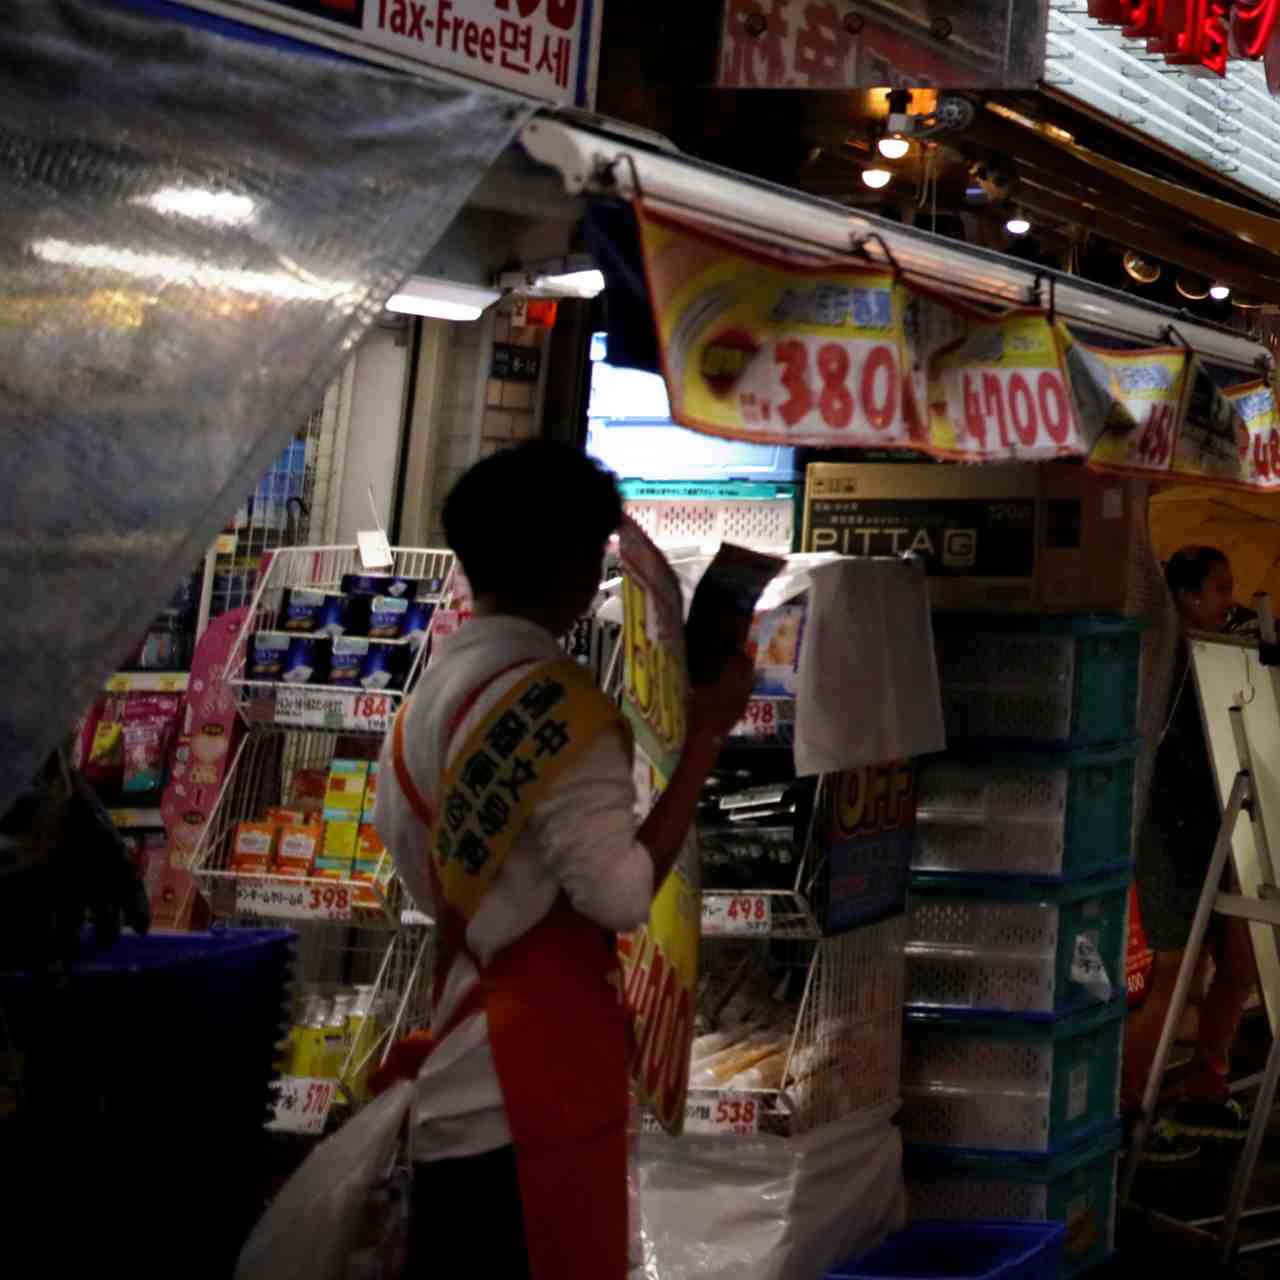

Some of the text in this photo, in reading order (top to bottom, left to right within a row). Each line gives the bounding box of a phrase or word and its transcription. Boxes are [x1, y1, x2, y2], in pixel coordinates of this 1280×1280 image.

[500, 24, 571, 89] 면세
[774, 337, 897, 431] 380
[810, 527, 937, 558] PITTA
[308, 890, 349, 911] 398
[726, 900, 765, 921] 498
[716, 1100, 755, 1123] 538
